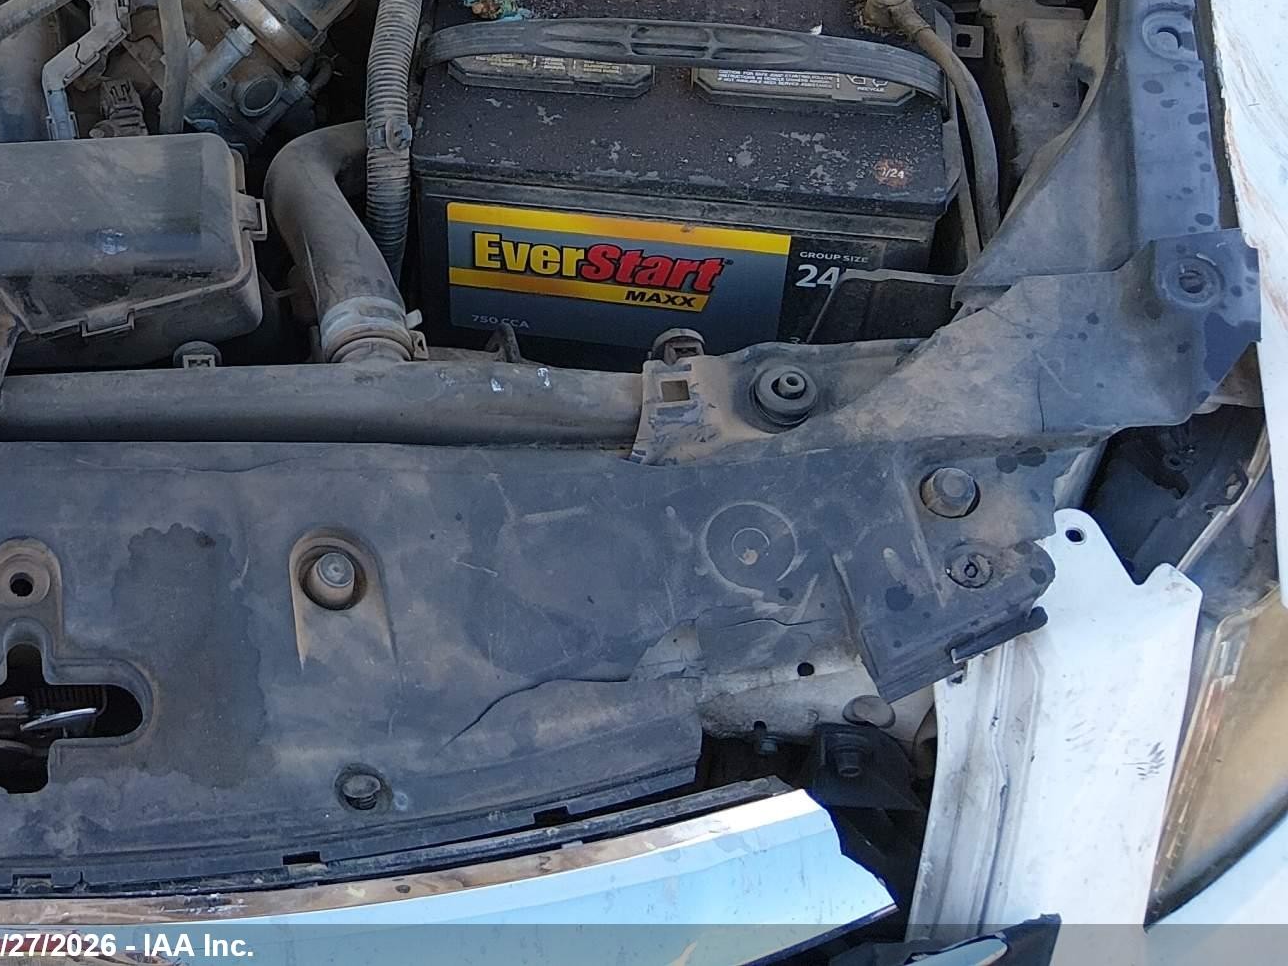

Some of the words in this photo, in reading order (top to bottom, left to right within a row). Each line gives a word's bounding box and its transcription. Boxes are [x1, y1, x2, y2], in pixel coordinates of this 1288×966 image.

[473, 231, 724, 292] EverStart
[799, 251, 841, 260] GROUP
[842, 255, 869, 263] SIZE
[625, 290, 697, 308] MAXX
[472, 314, 499, 324] 750
[500, 317, 530, 329] CCA
